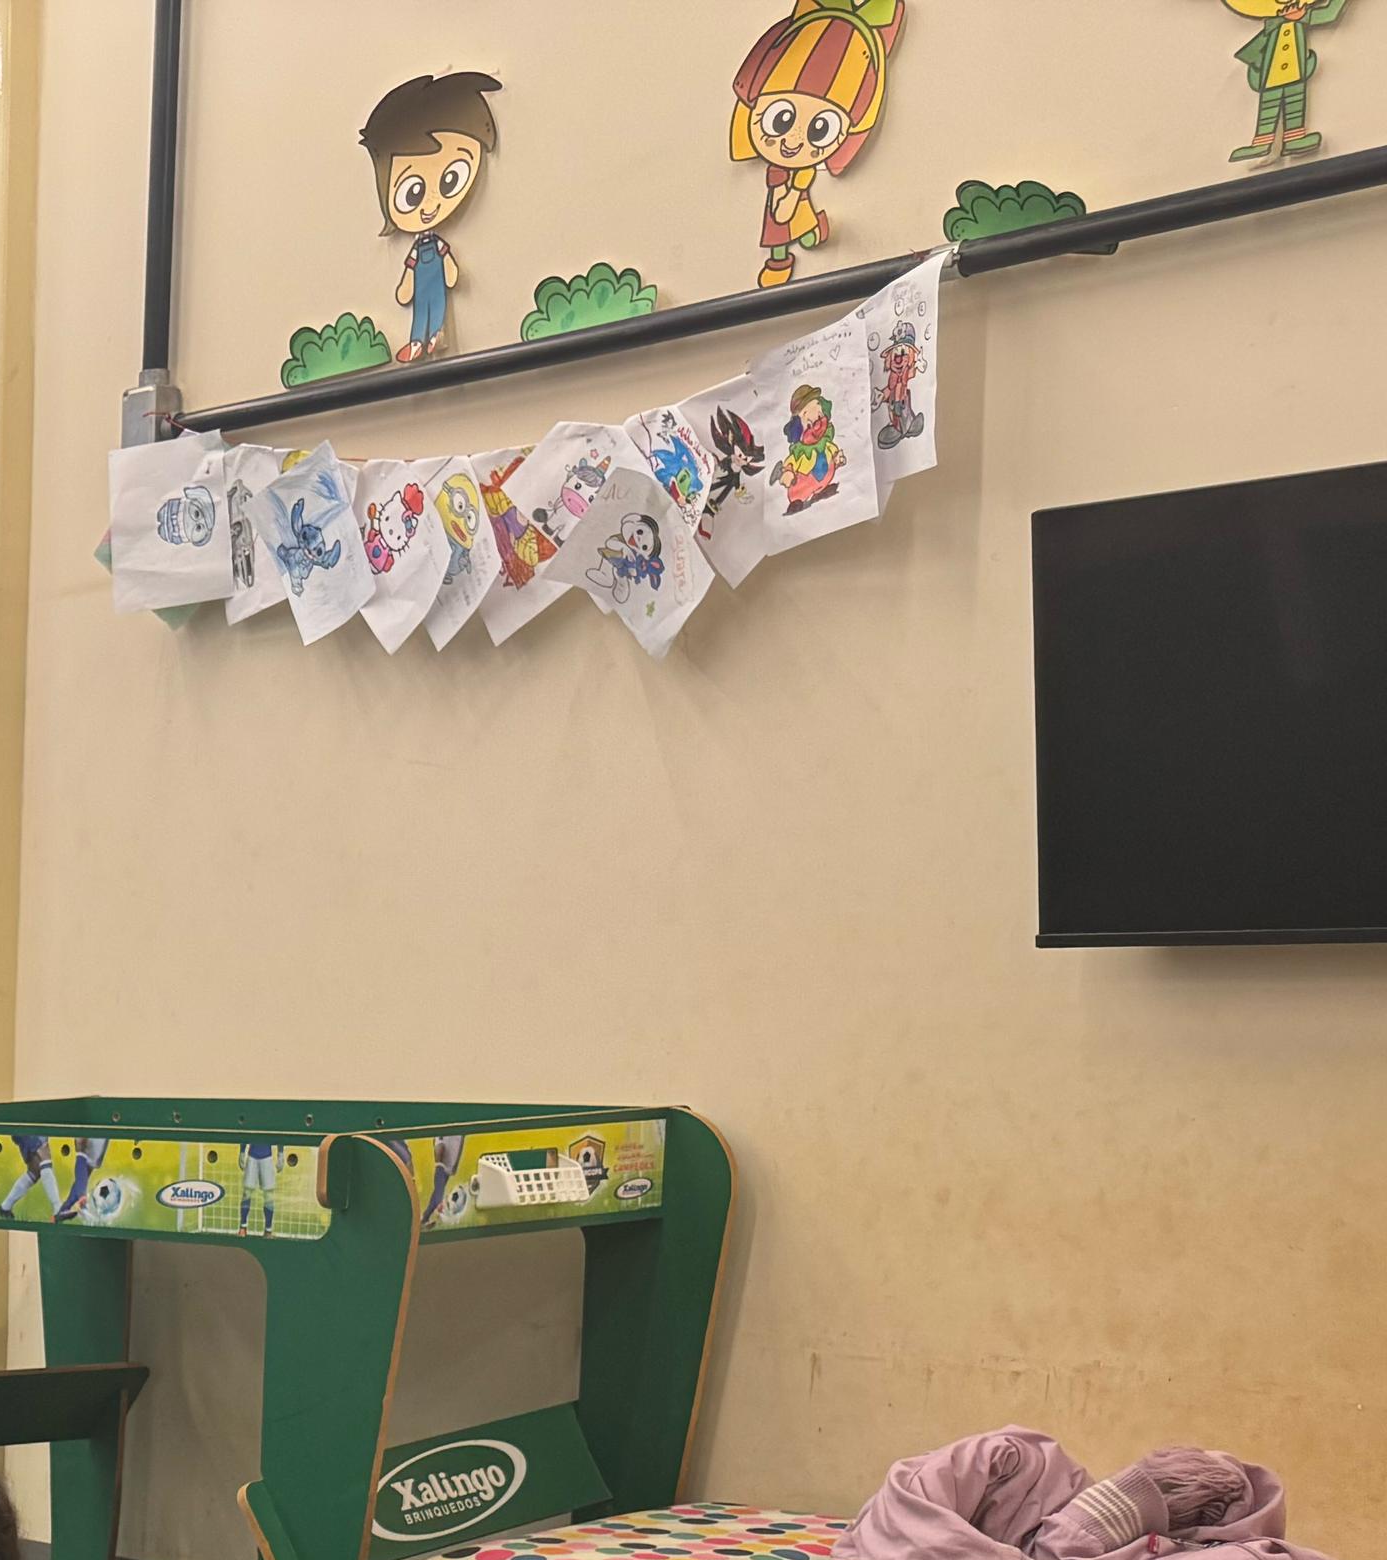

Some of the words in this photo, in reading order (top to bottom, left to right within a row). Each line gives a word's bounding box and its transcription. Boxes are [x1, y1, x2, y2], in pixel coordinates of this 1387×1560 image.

[170, 1186, 215, 1203] Xalingo
[390, 1464, 506, 1512] Xalingo
[404, 1496, 482, 1525] BRINQUEDOS
